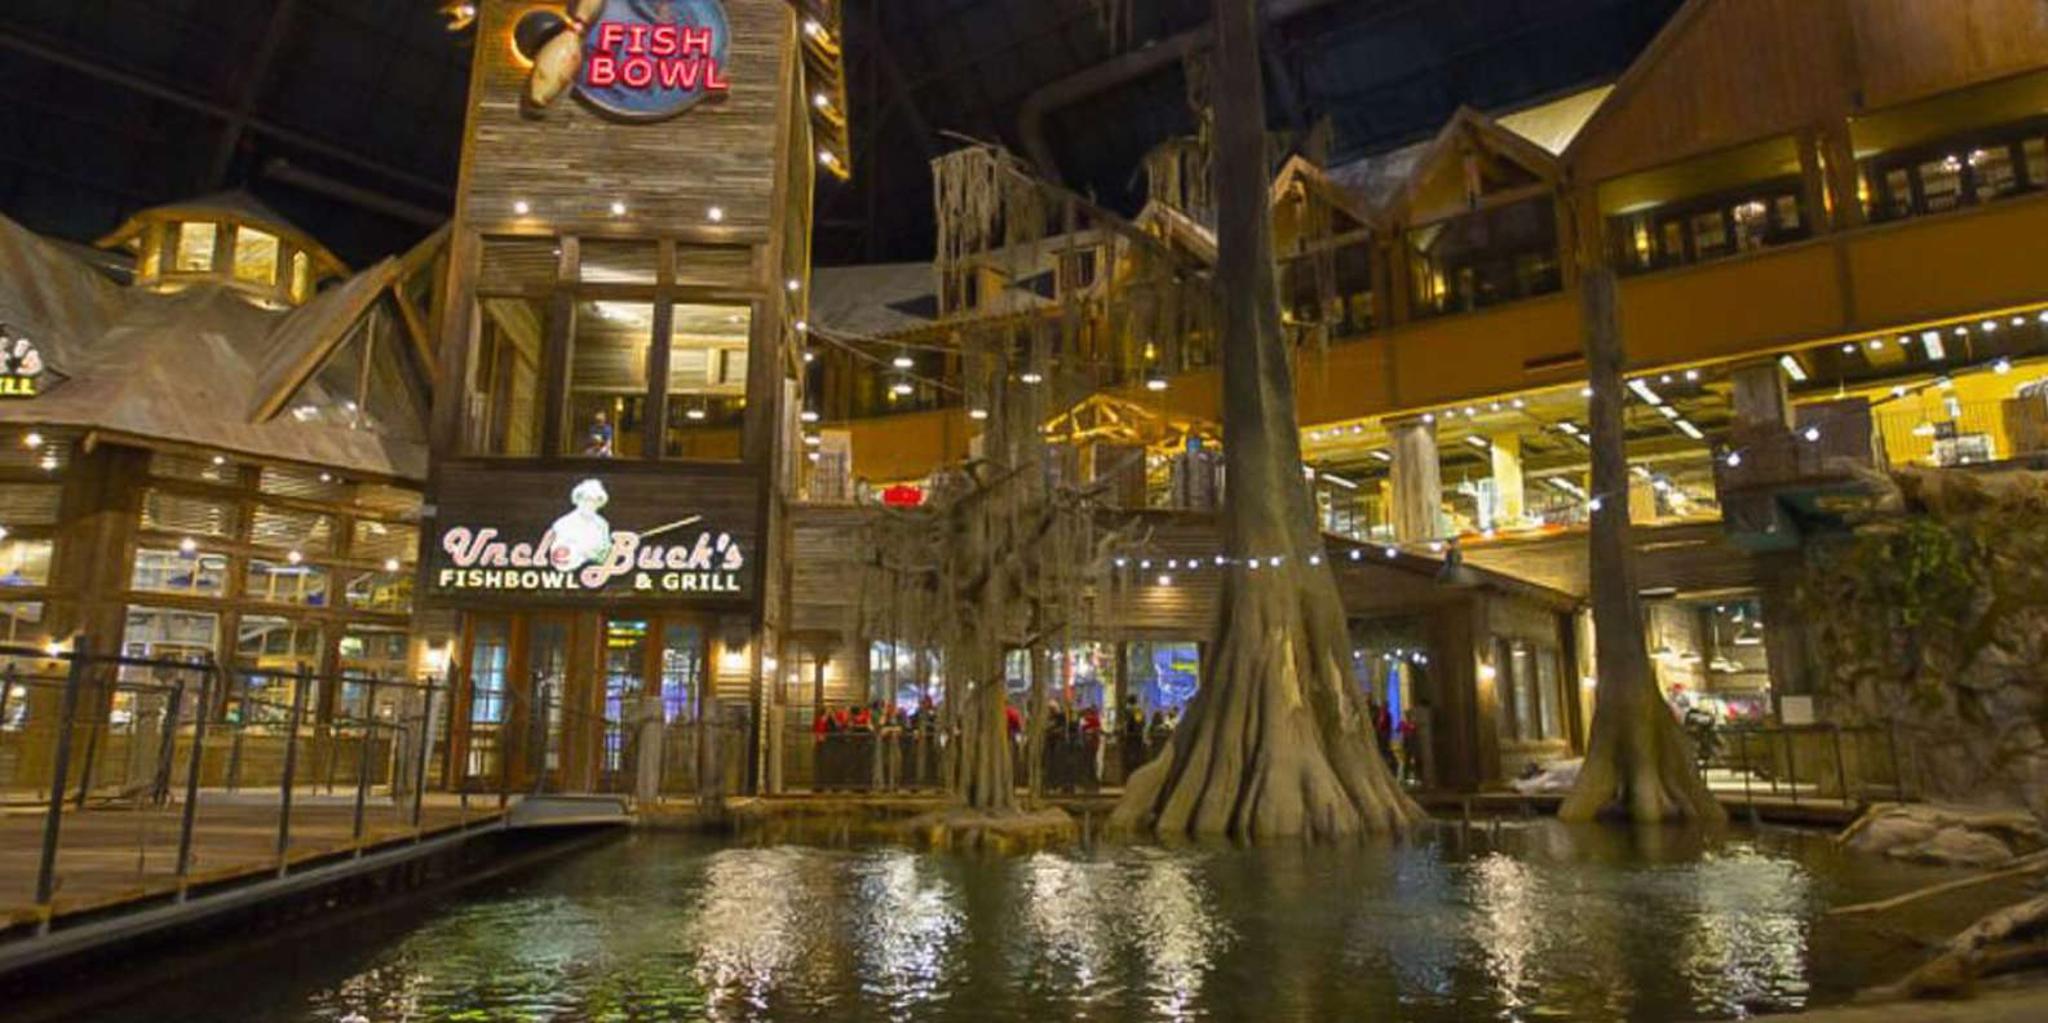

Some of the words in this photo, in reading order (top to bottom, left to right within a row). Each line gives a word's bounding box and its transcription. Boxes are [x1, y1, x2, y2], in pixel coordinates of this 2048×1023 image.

[601, 23, 712, 56] FISH
[589, 57, 728, 90] BOWL
[443, 526, 572, 570] Uncle
[580, 531, 744, 588] Buck's
[439, 568, 581, 589] FISHBOWL
[635, 572, 652, 590] &
[662, 573, 740, 591] GRILL
